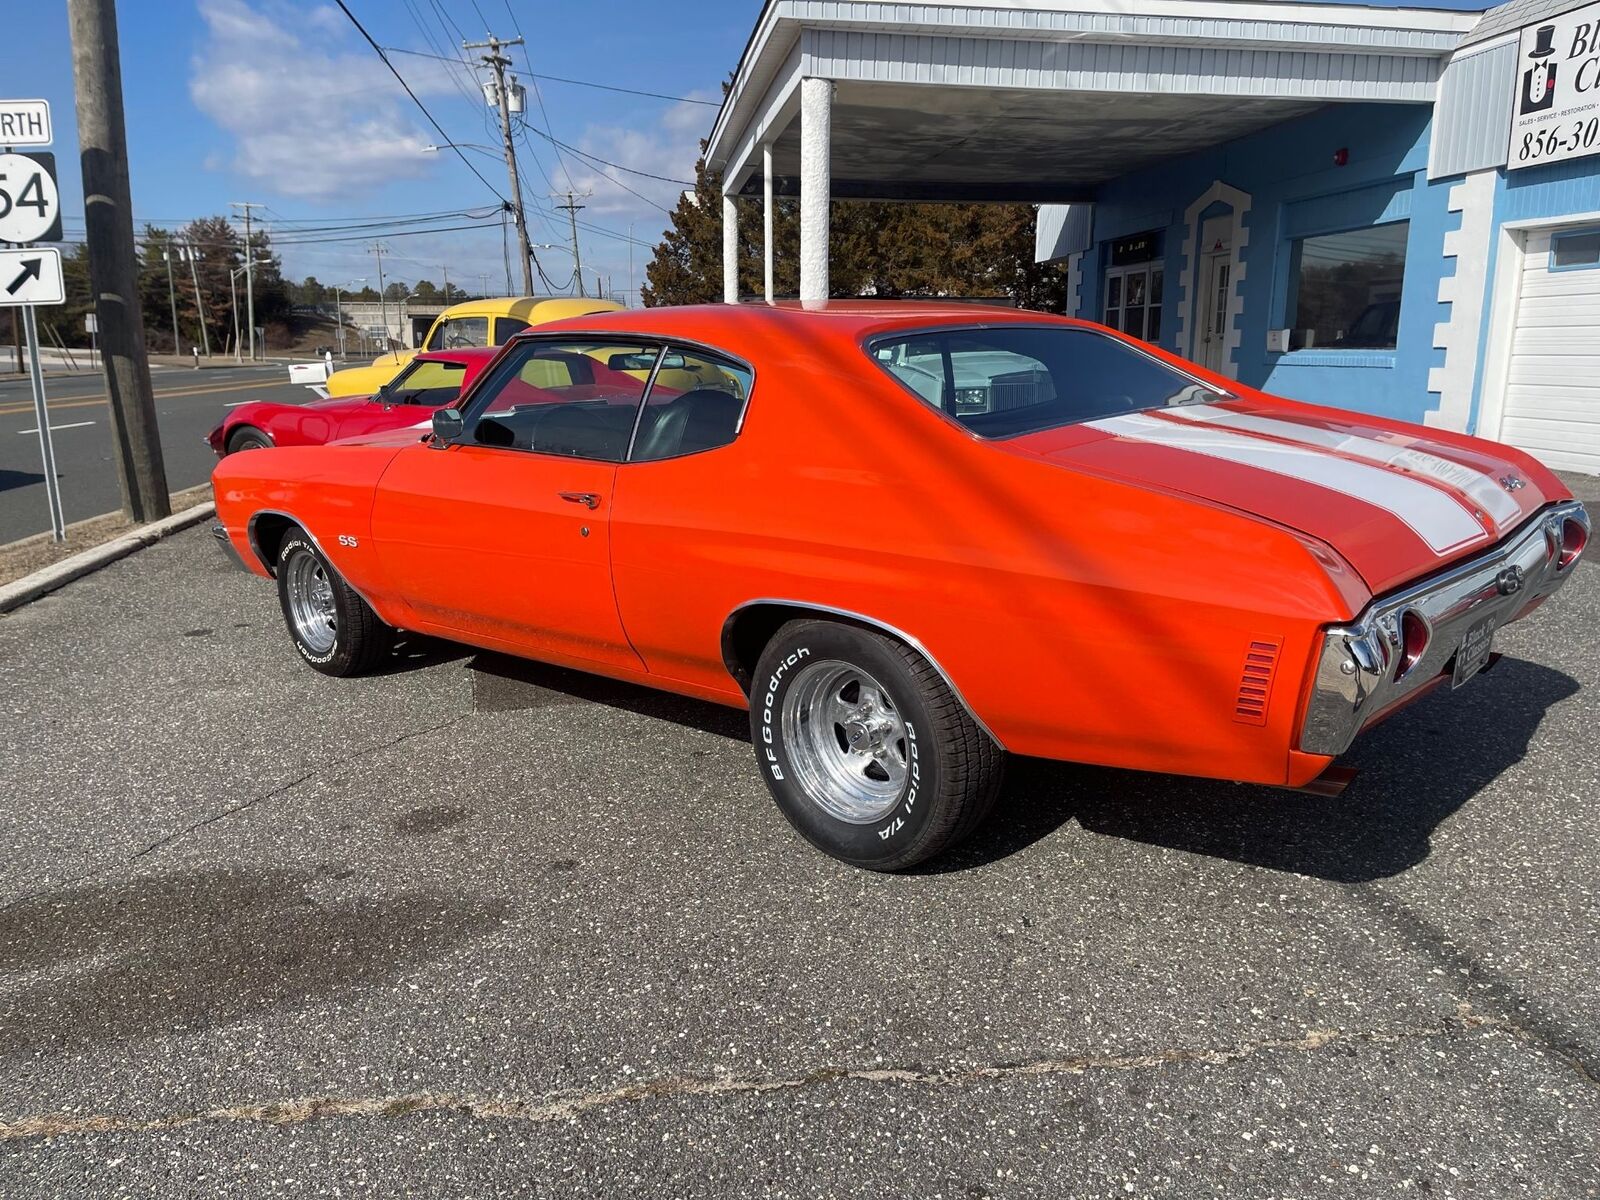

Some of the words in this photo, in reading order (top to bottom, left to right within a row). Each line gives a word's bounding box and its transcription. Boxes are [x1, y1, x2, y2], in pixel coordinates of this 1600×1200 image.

[1519, 118, 1534, 127] SALES
[1537, 112, 1557, 122] SERVICE
[1561, 102, 1596, 116] RESTORATION
[1519, 116, 1600, 161] 856-30
[281, 540, 301, 561] Radial
[338, 534, 358, 548] SS
[904, 721, 921, 815] Radial
